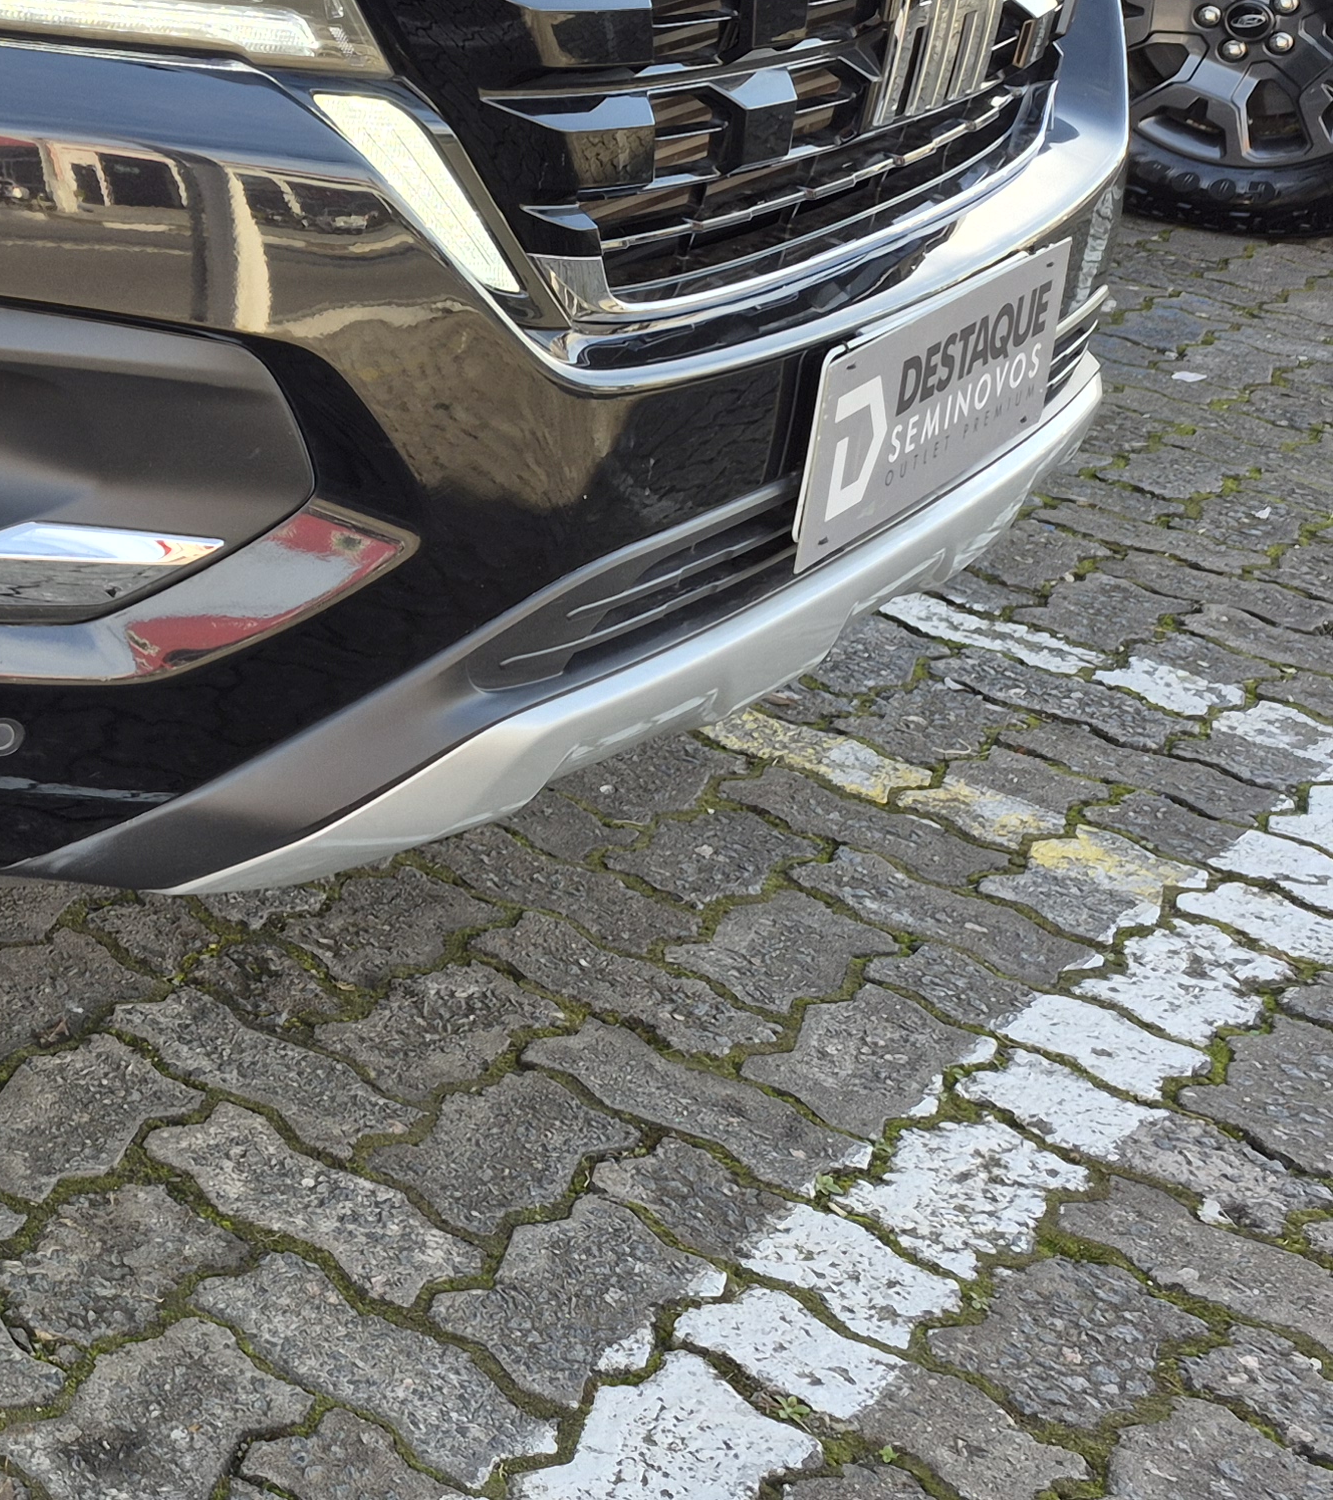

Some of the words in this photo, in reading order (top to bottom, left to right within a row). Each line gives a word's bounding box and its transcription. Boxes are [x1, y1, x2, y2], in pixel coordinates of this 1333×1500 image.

[887, 342, 1042, 463] SEMINOVOS
[896, 280, 1053, 416] DESTAQUE
[884, 435, 951, 487] OUTLET
[962, 385, 1034, 440] PREMIUM
